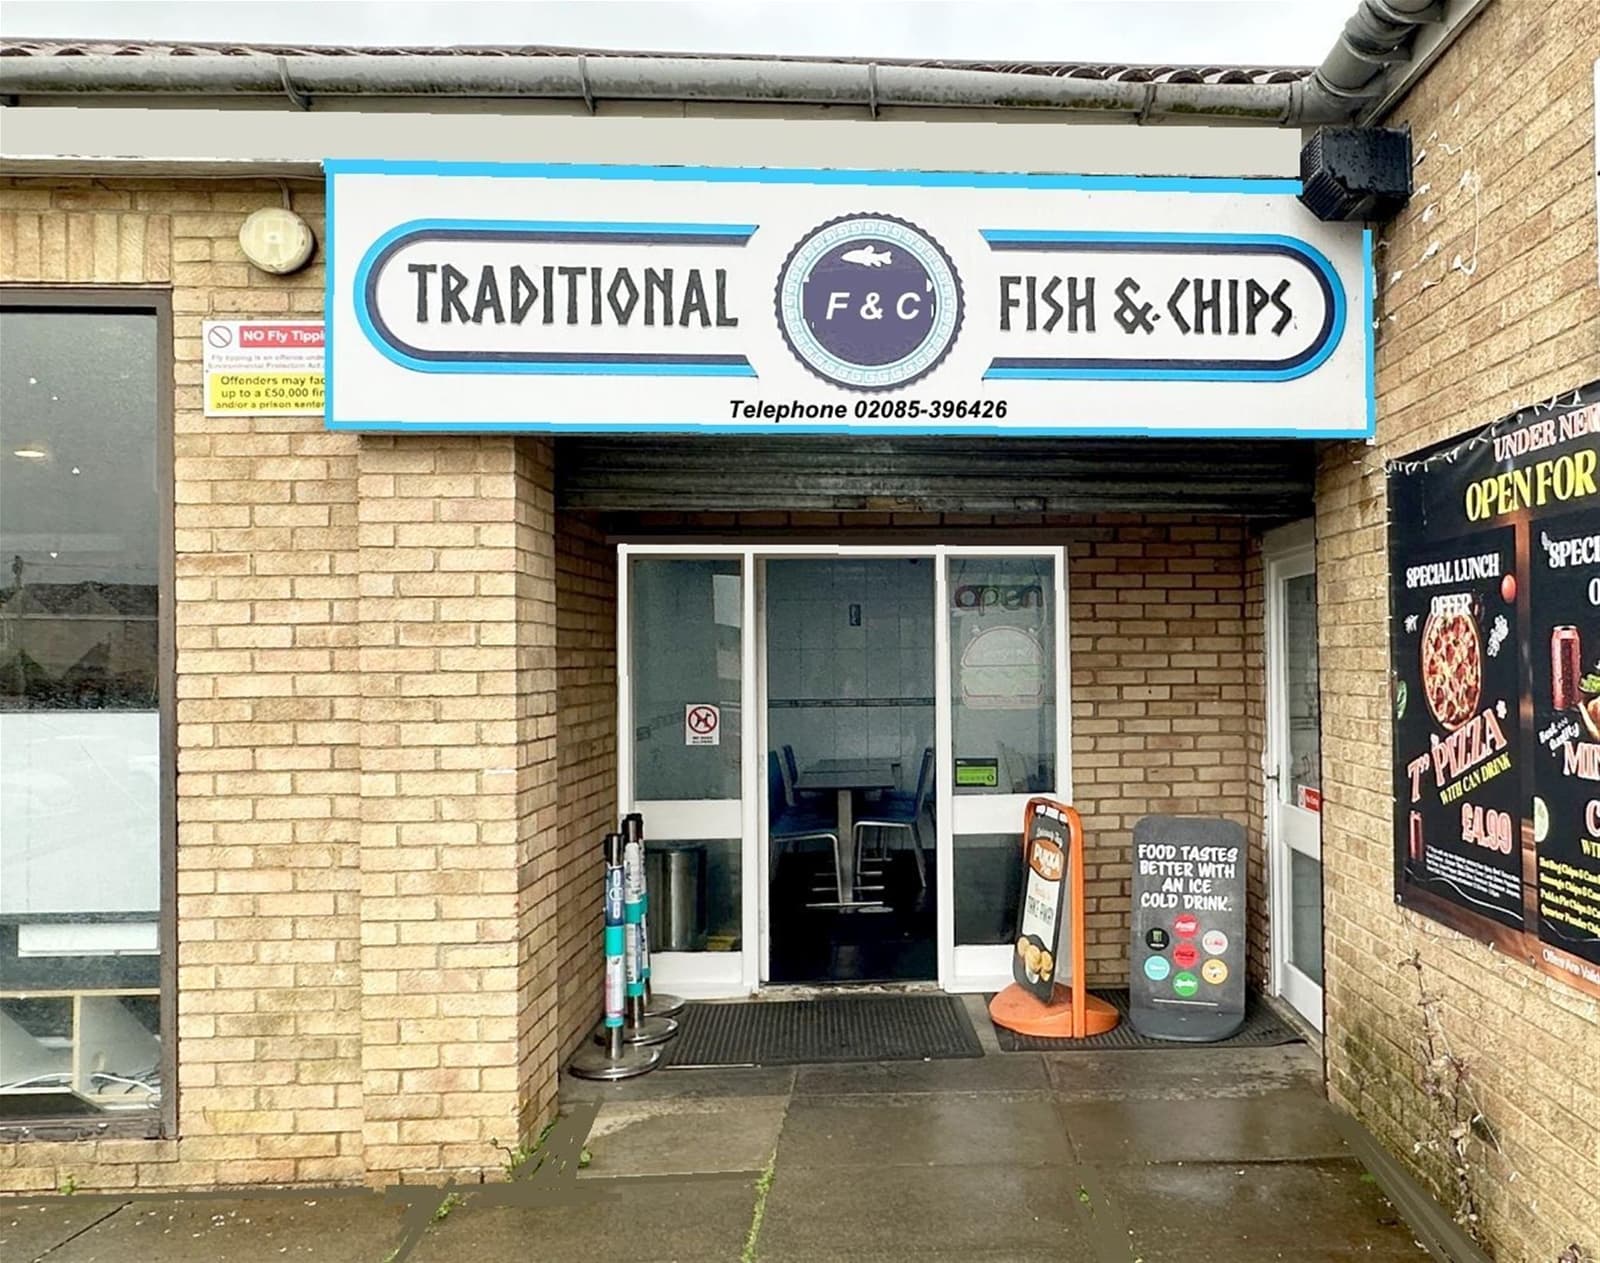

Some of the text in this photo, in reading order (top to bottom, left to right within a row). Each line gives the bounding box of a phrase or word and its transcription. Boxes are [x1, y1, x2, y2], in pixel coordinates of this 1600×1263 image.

[408, 264, 738, 327] TRADITIONAL
[826, 292, 921, 320] F & C
[1000, 276, 1293, 337] FISH & CHIPS
[243, 330, 265, 341] NO
[267, 330, 288, 344] Fly
[220, 376, 279, 386] Offenders
[281, 378, 306, 388] may
[221, 390, 237, 400] up
[239, 388, 252, 398] to
[254, 390, 262, 398] a
[264, 388, 309, 399] £50,000
[259, 400, 292, 410] prison
[730, 400, 1008, 423] Telephone 02085-396426
[1493, 419, 1557, 463] UNDER
[1465, 449, 1598, 521] OPEN FOR
[1406, 552, 1500, 589] SPECIAL LUNCH
[1430, 593, 1472, 617] OFFER
[1431, 707, 1508, 787] PIZZA
[1439, 751, 1512, 806] WITH CAN DRINK
[1461, 802, 1512, 855] £4.99
[1137, 844, 1239, 863] FOOD TASTES
[1139, 860, 1236, 879] BETTER WITH
[1161, 877, 1212, 894] AN ICE
[1140, 892, 1233, 912] COLD DRINK.
